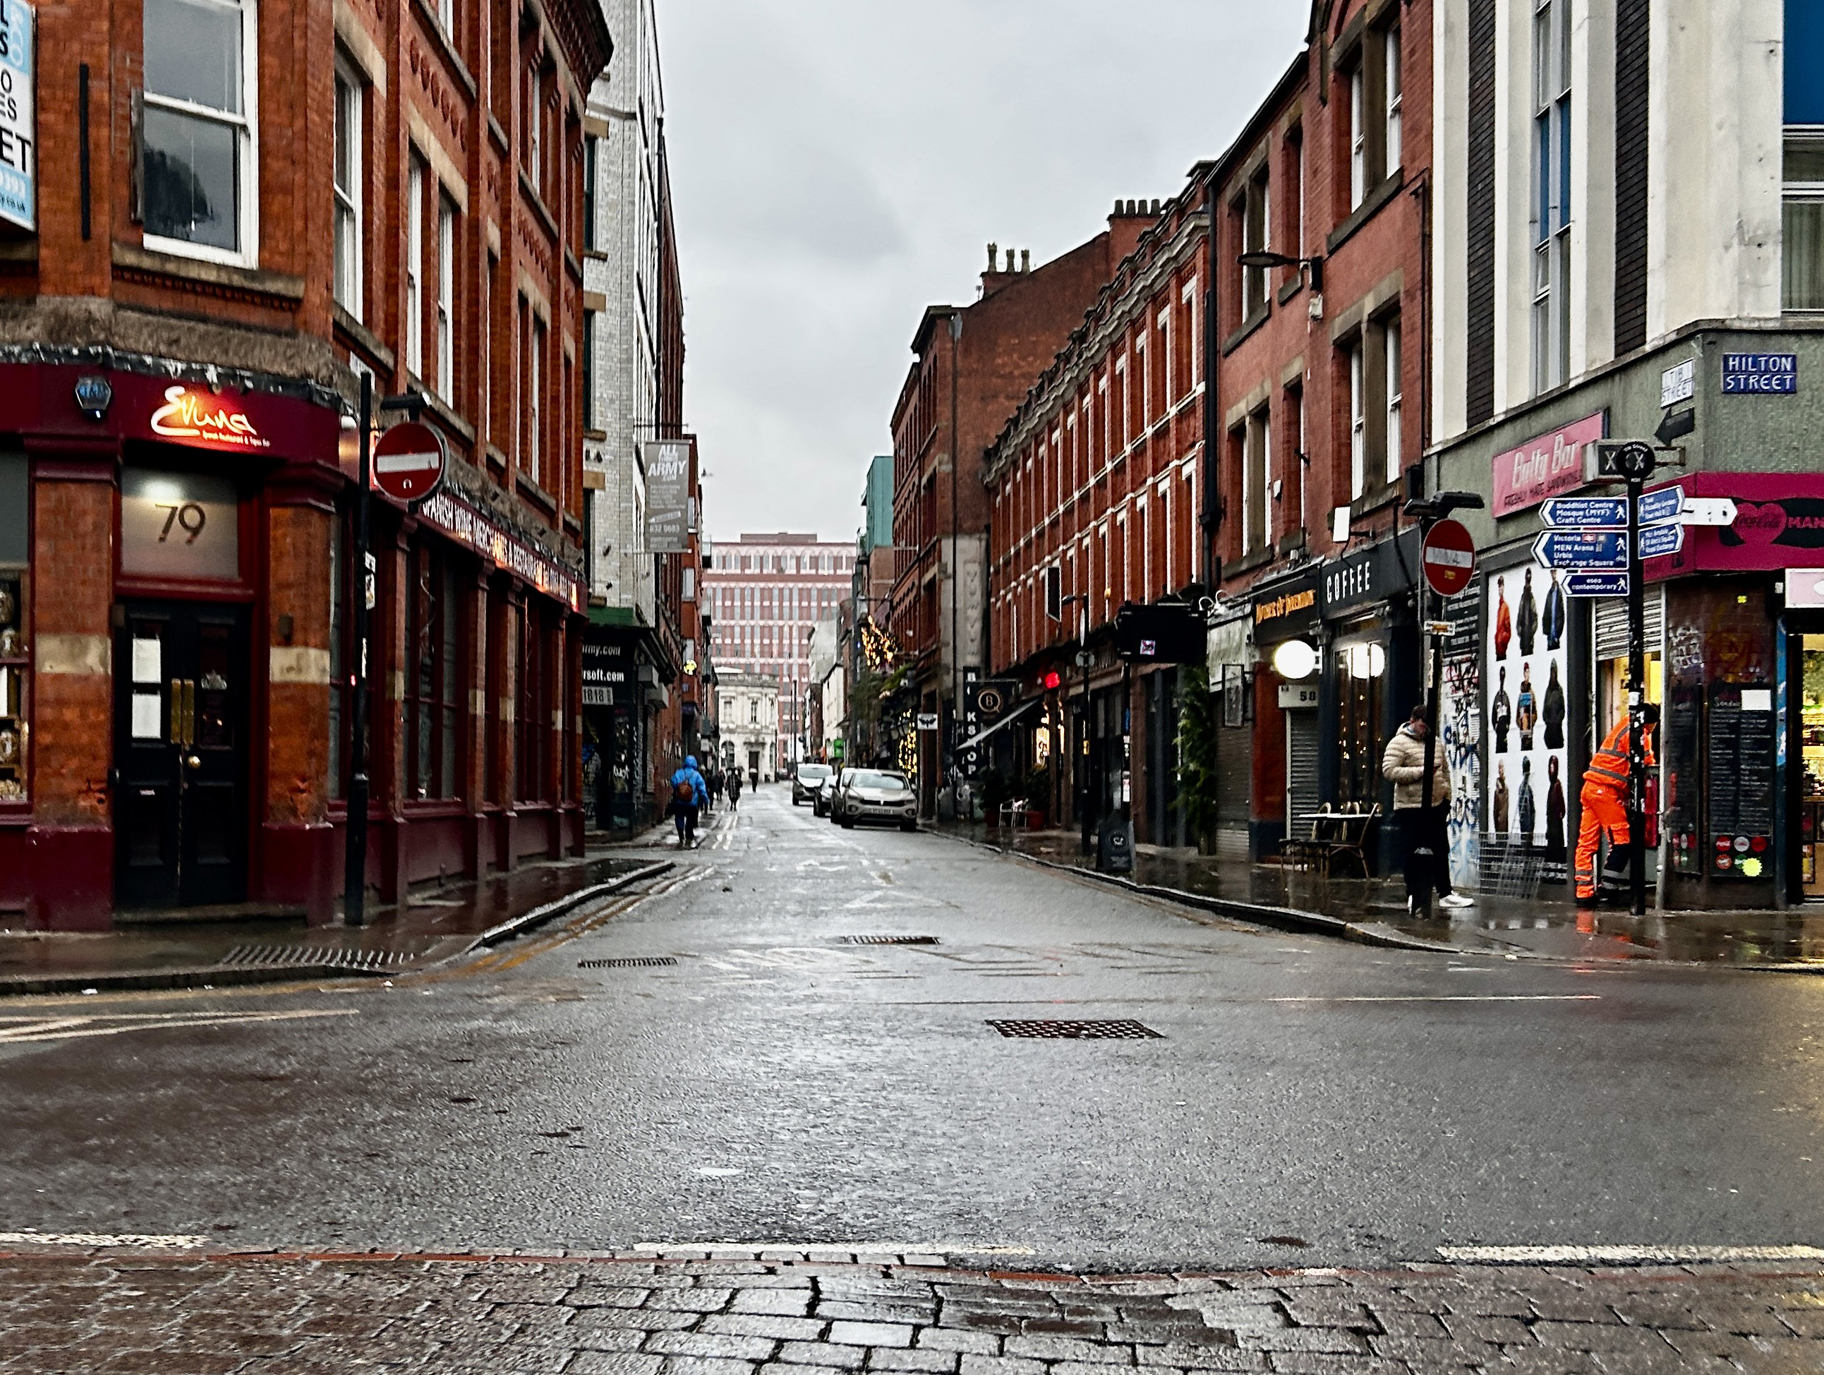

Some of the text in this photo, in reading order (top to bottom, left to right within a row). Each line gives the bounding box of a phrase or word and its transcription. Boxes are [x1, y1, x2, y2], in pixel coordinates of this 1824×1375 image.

[1728, 356, 1793, 372] HILTON
[1726, 374, 1794, 390] STREET
[1661, 380, 1692, 403] STREET
[1551, 433, 1579, 474] Bar
[648, 460, 687, 477] ARMY
[1556, 509, 1584, 517] Mosque
[154, 502, 206, 545] 79
[1553, 534, 1581, 542] Victoria
[1589, 559, 1614, 567] Square
[1326, 561, 1370, 604] COFFEE
